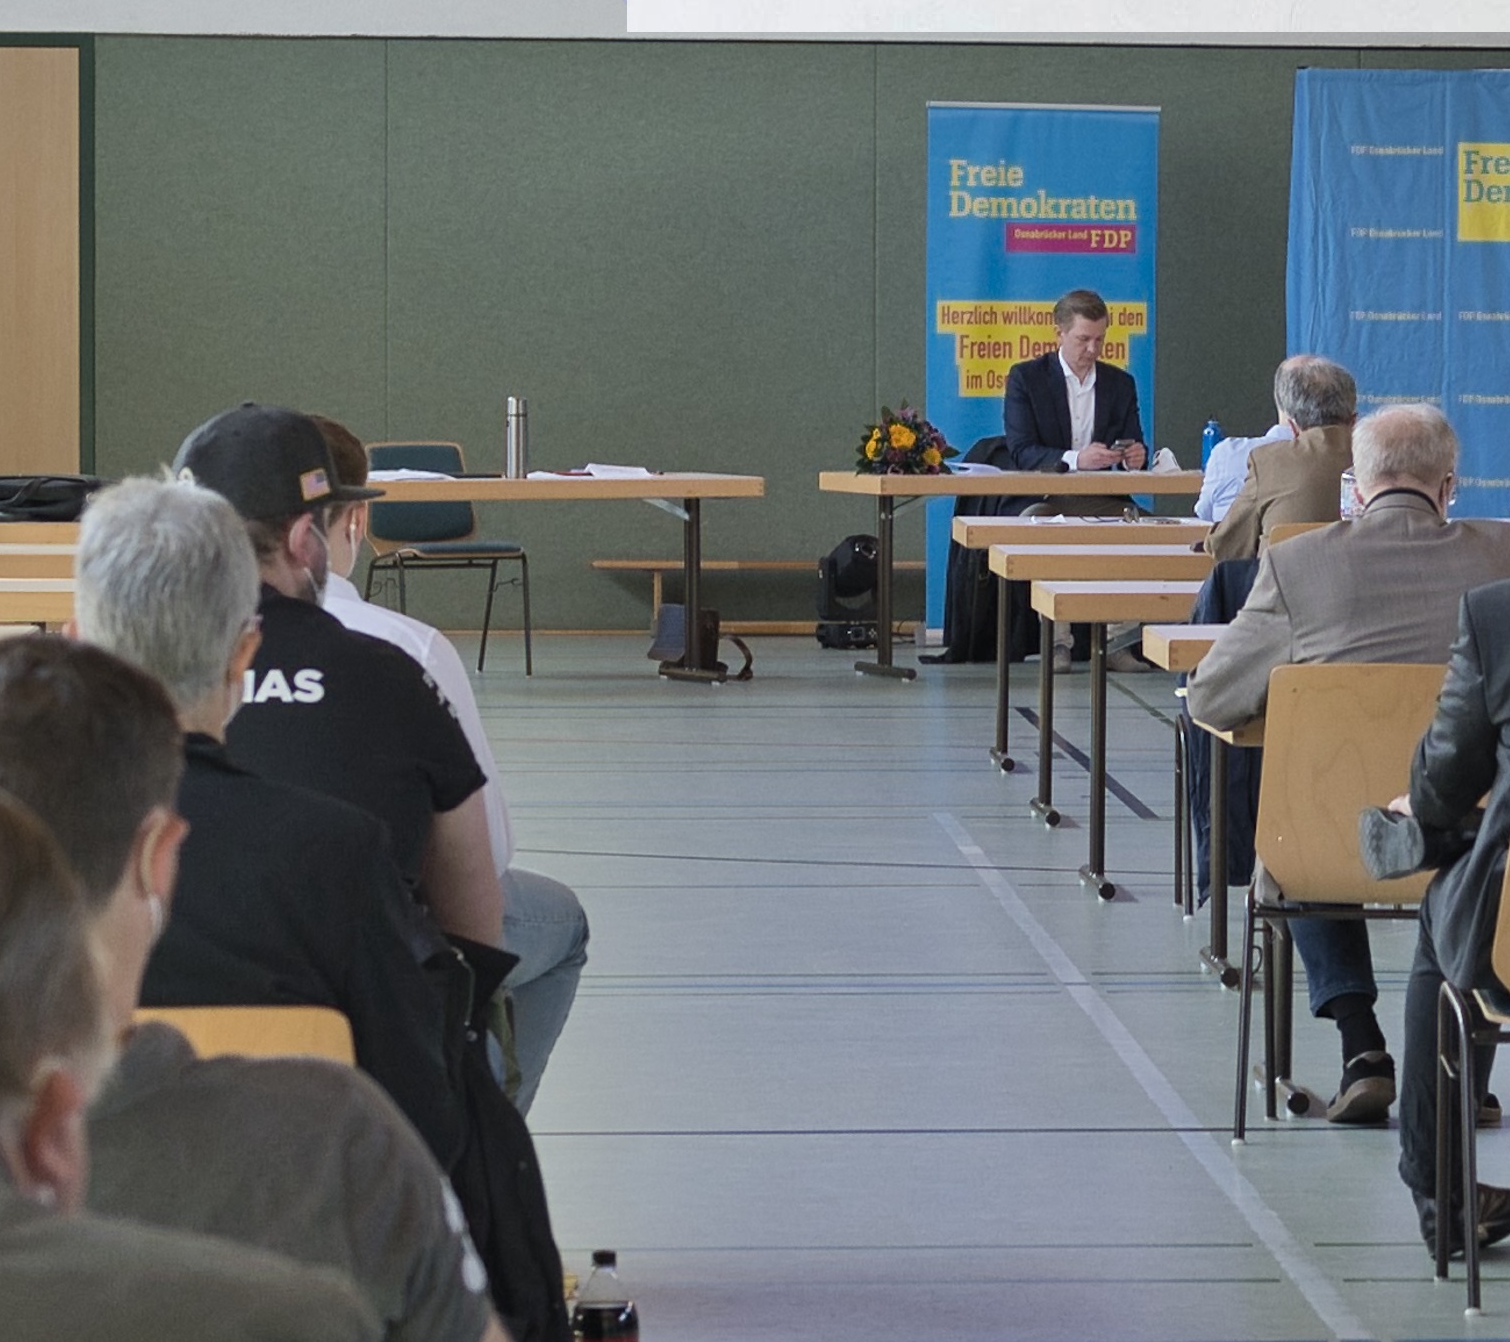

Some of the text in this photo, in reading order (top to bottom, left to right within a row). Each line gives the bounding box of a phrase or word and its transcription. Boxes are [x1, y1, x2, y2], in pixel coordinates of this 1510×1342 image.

[949, 159, 1024, 186] Freie
[949, 190, 1137, 220] Demokraten
[1014, 228, 1132, 248] Osnabrücker Land FDP
[941, 305, 998, 325] Herzlich
[1002, 307, 1054, 326] willkom
[1118, 308, 1144, 327] den
[959, 335, 1013, 359] Freien
[966, 370, 983, 389] im
[242, 668, 325, 703] IAS
